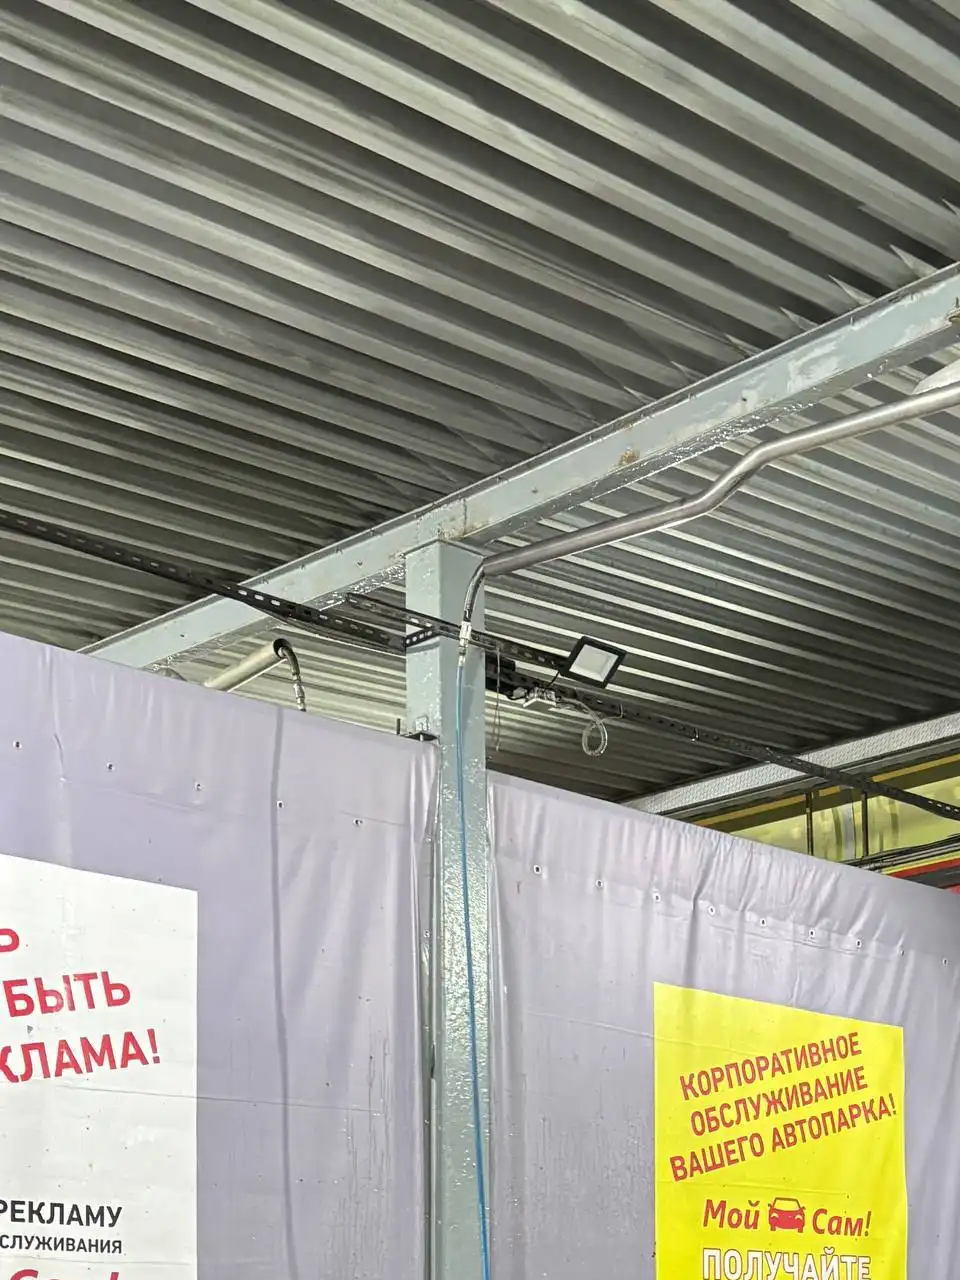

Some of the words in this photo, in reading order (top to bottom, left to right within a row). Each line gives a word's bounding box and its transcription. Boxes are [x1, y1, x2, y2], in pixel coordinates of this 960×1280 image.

[2, 971, 131, 1017] БЫТЬ
[679, 1032, 862, 1100] КОРПОРАТИВНОЕ
[690, 1066, 868, 1136] ОБСЛУЖИВАНИЕ
[669, 1133, 765, 1182] ВАШЕГО
[771, 1093, 897, 1153] АВТОПАРКА!
[0, 1234, 122, 1254] СЛУЖИВАНИЯ
[703, 1199, 761, 1230] Мой
[811, 1208, 872, 1237] Сам!
